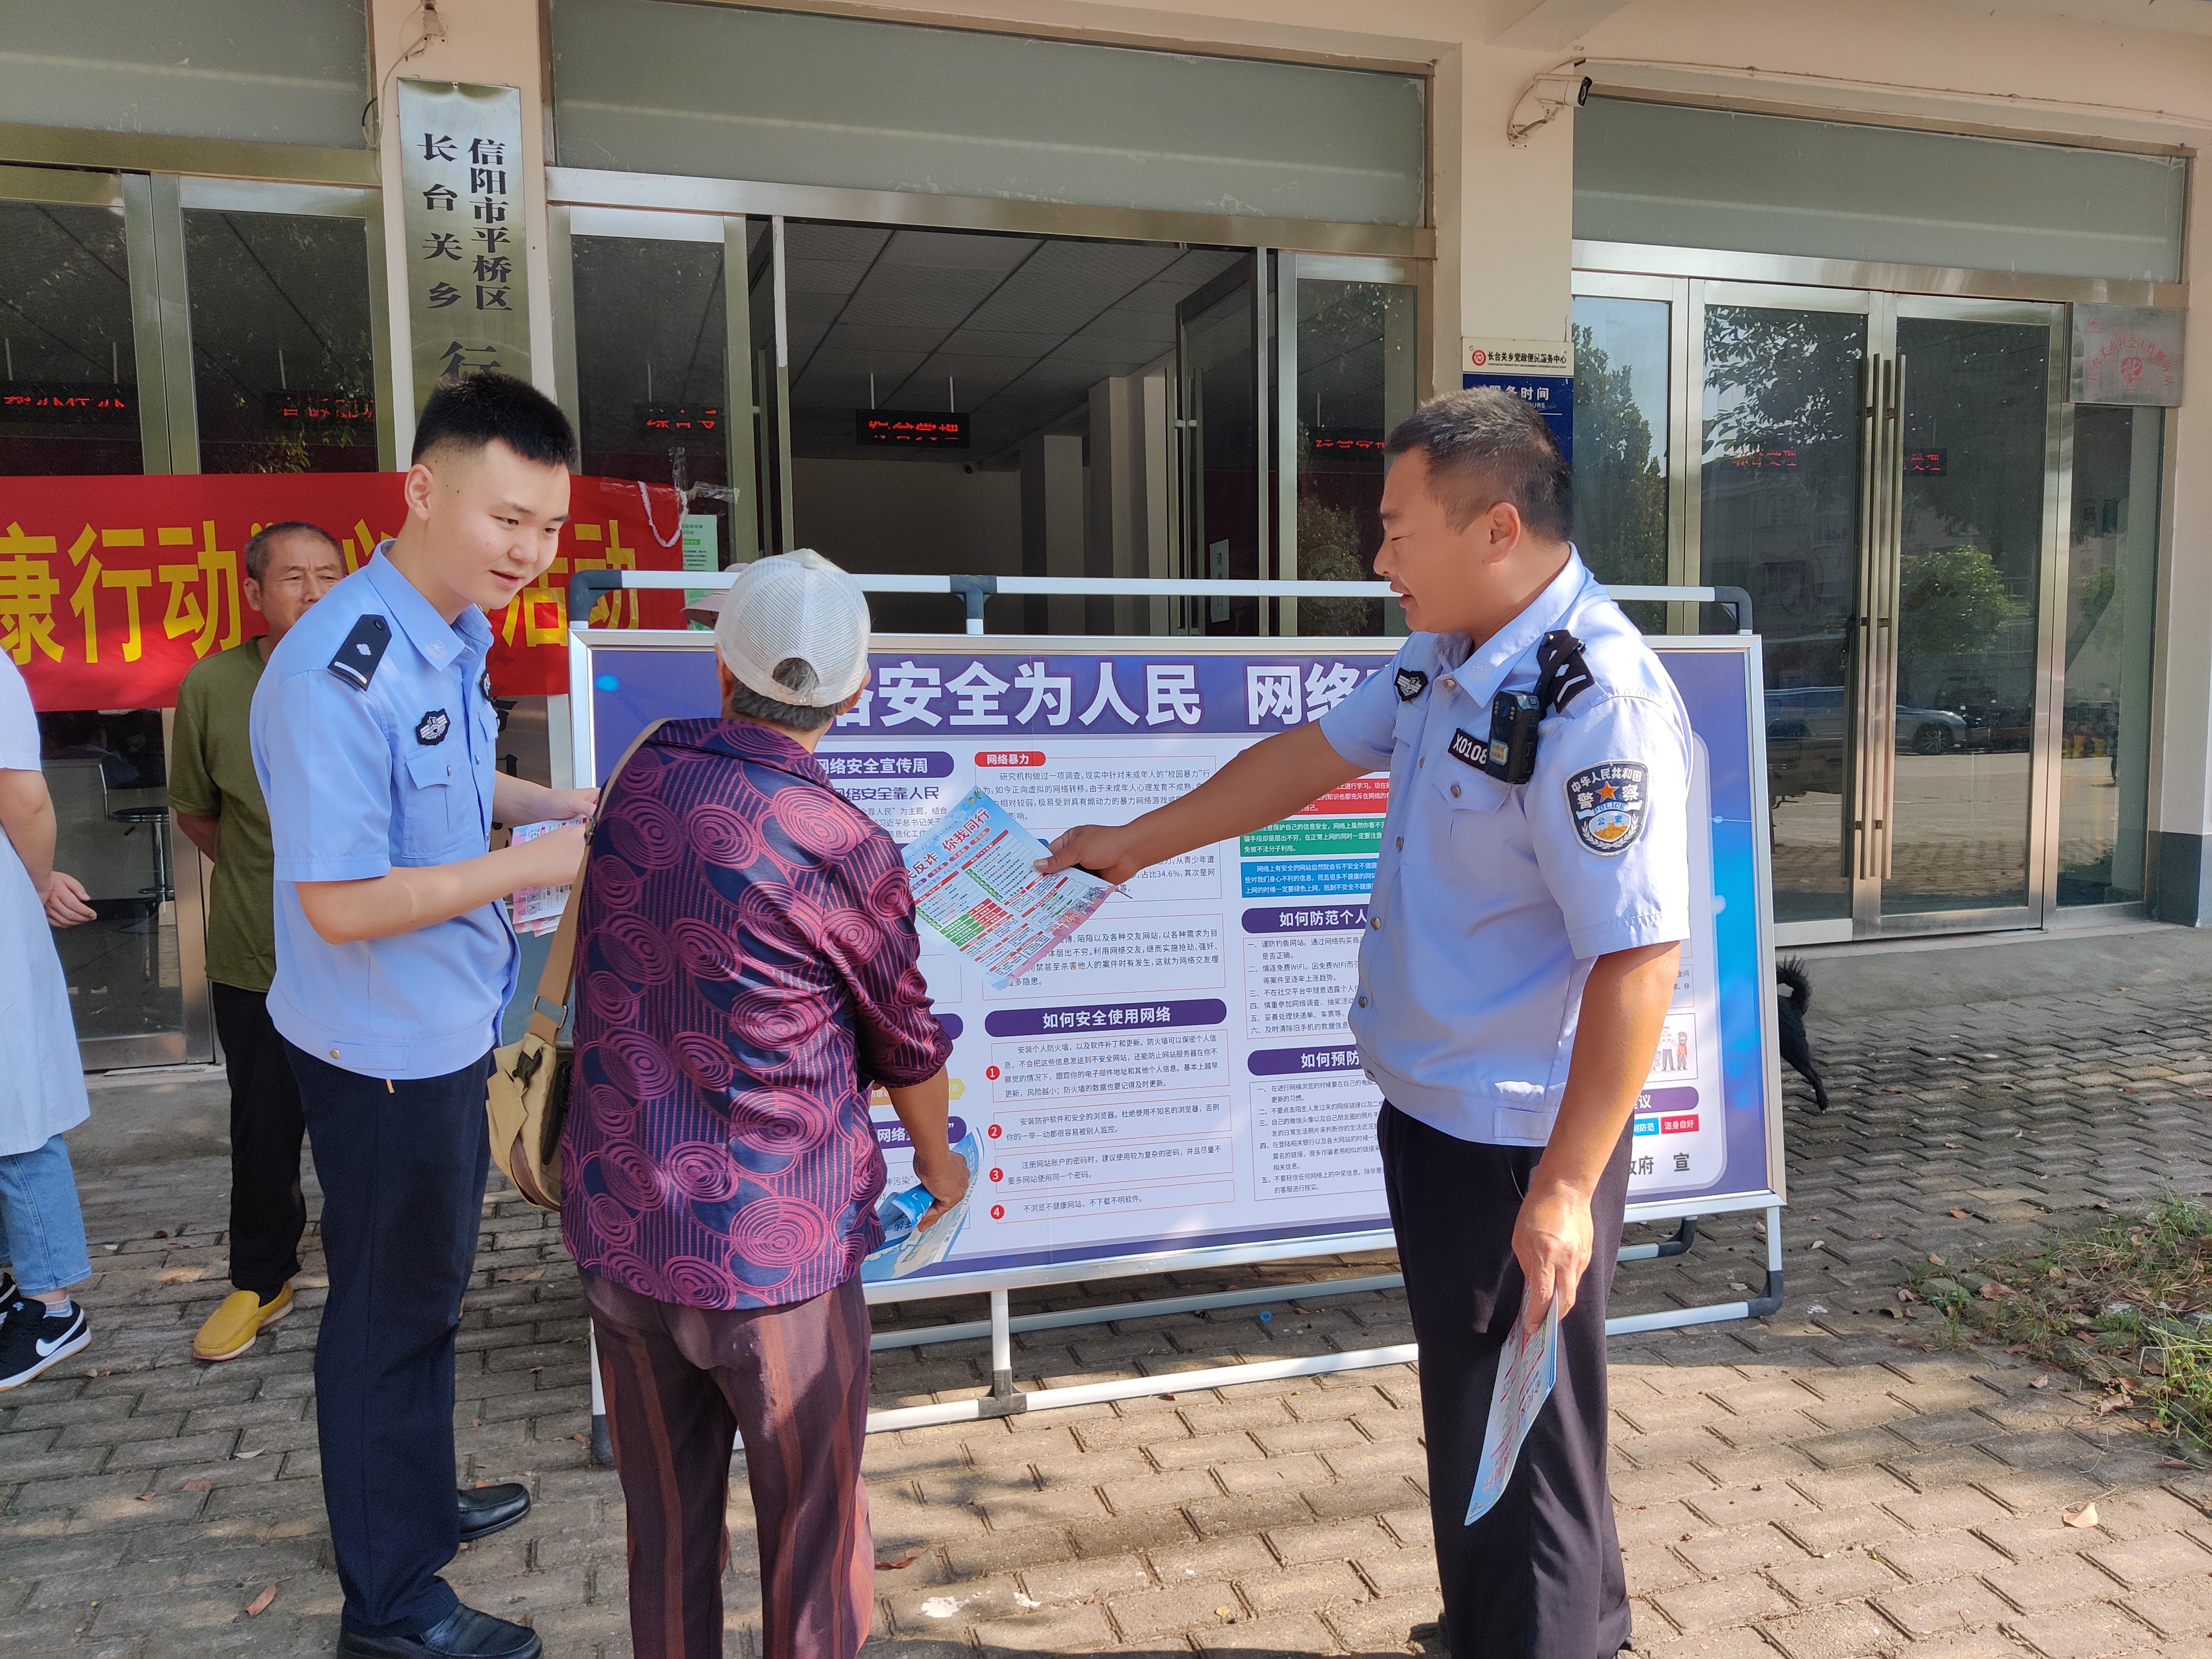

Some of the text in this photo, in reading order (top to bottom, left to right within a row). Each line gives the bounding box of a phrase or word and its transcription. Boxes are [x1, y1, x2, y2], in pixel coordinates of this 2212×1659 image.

[417, 133, 463, 309] 长台关乡
[467, 138, 513, 311] 信阳市平桥区
[1488, 351, 1567, 364] 长台关乡党政便民服务中心
[1490, 385, 1549, 400] 务时间
[1246, 662, 1389, 724] 网络
[987, 754, 1029, 765] 网络暴力
[1571, 767, 1642, 792] 中华人民共和国
[1577, 784, 1639, 810] 警 察
[1593, 802, 1625, 814] POLICE
[941, 808, 990, 852] 你我同行
[1279, 909, 1367, 927] 如何防范个人
[1042, 1006, 1171, 1029] 如何安全使用网络
[1301, 1050, 1359, 1068] 如何预防
[1634, 1094, 1651, 1109] 议
[991, 1126, 998, 1136] 2
[1673, 1152, 1690, 1172] 宣
[993, 1170, 999, 1180] 3
[994, 1207, 1000, 1217] 4
